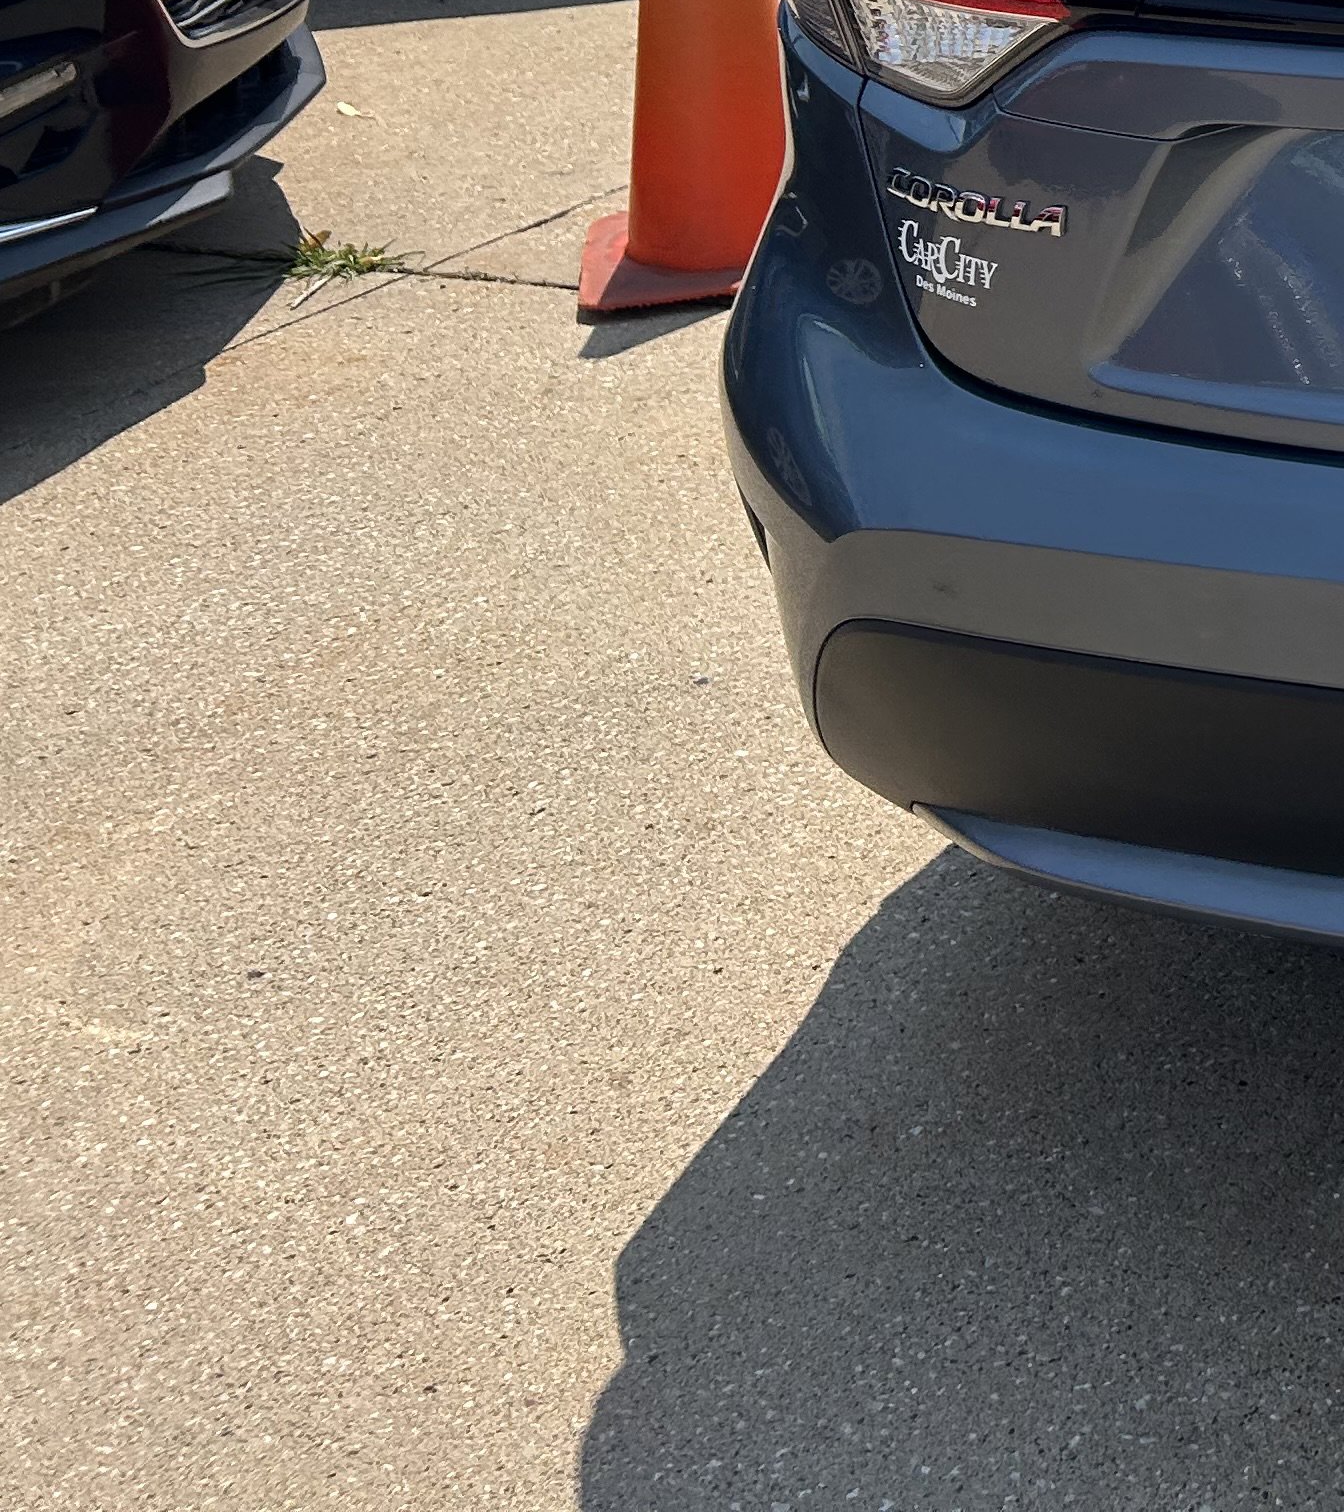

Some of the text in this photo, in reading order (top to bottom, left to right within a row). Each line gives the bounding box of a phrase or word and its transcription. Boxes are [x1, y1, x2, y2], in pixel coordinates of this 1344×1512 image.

[887, 167, 1068, 237] COROLLA
[915, 274, 977, 307] Des Moines
